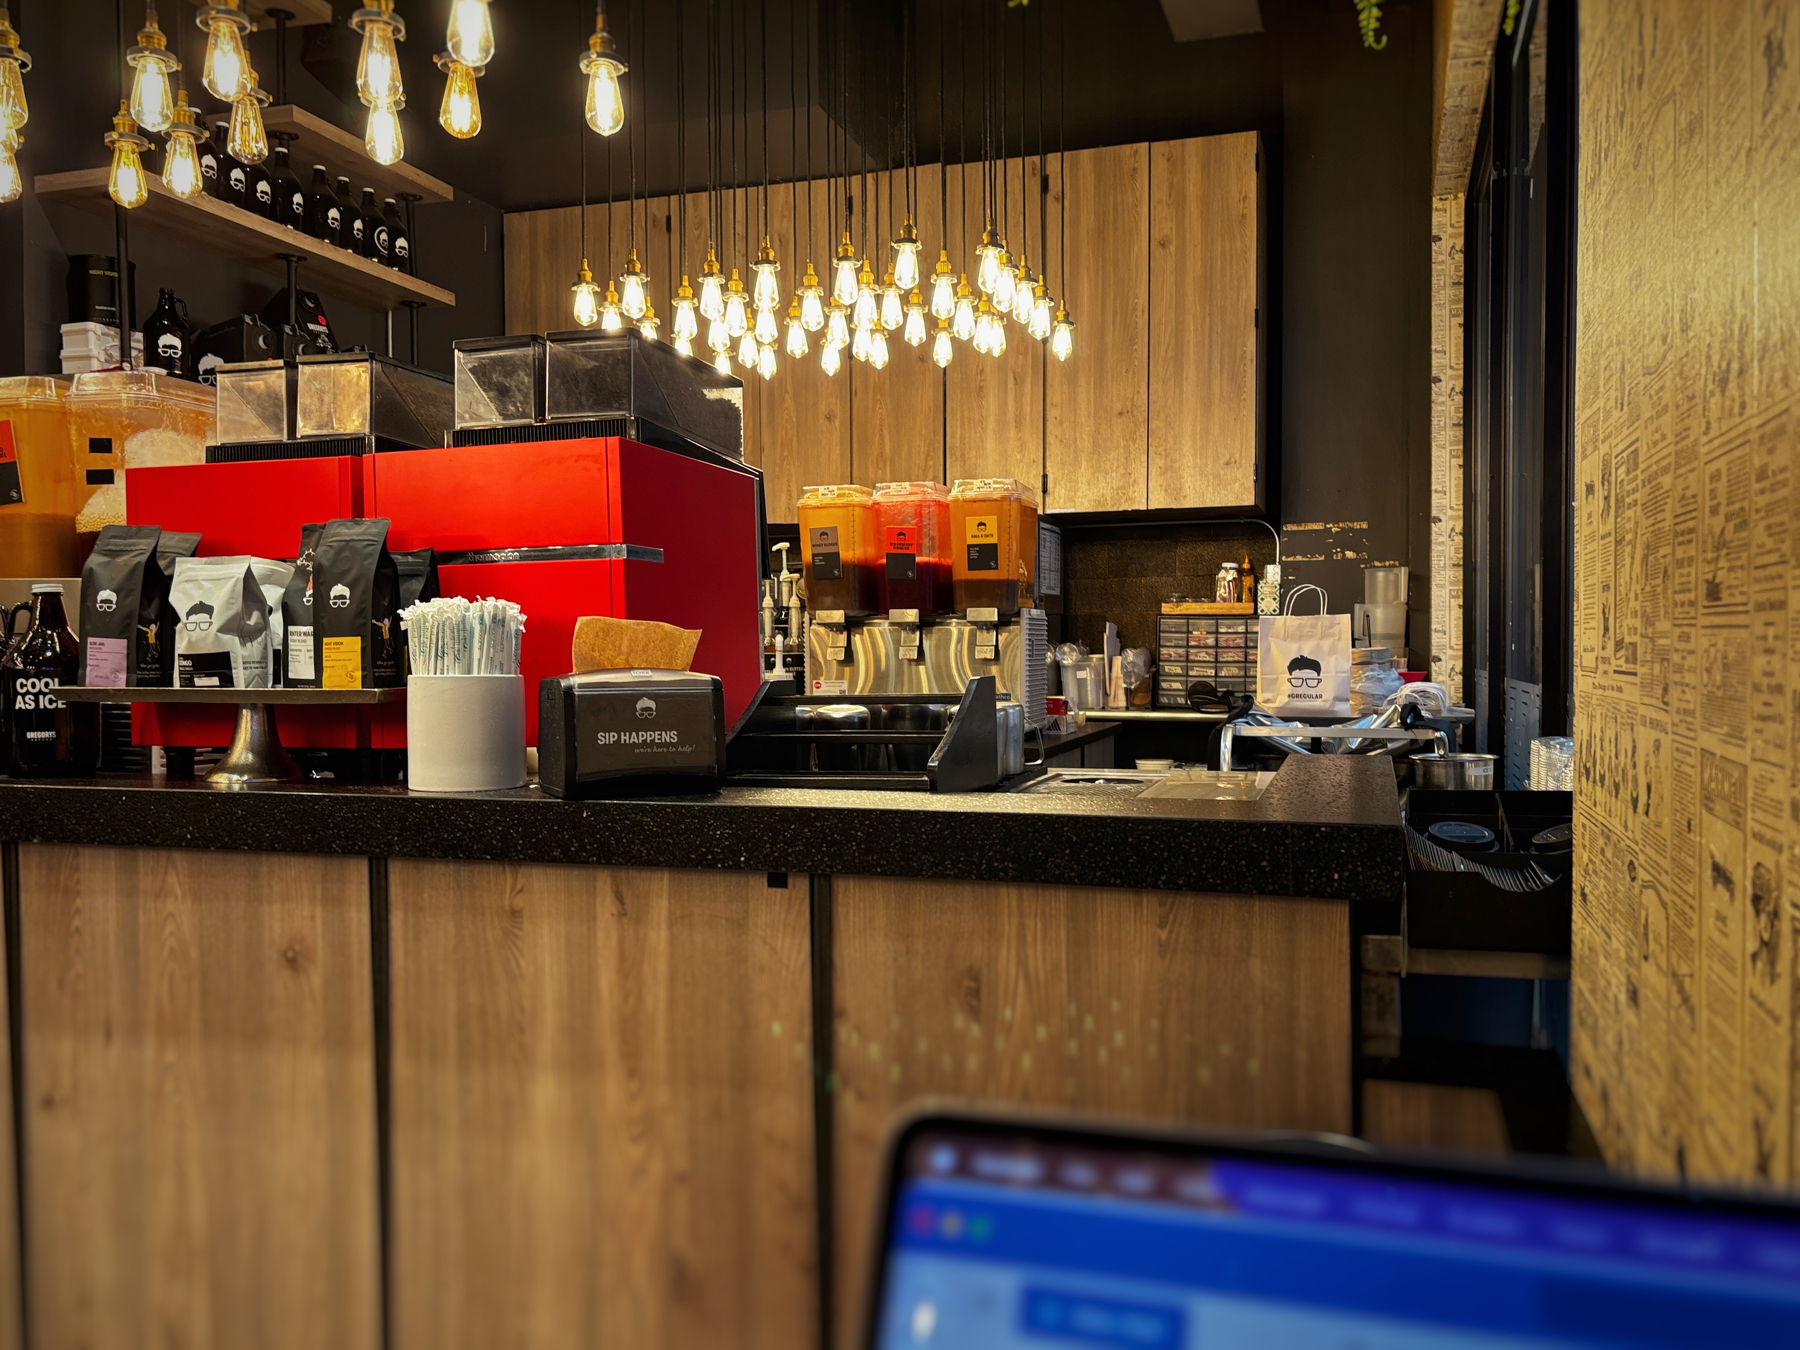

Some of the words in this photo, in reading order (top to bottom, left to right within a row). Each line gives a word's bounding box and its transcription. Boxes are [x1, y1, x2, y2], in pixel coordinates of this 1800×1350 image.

[15, 694, 36, 710] AS
[26, 731, 57, 739] GREGORYS
[597, 732, 618, 745] SIP
[620, 730, 678, 744] HAPPENS
[652, 745, 668, 753] here
[677, 744, 696, 753] help!
